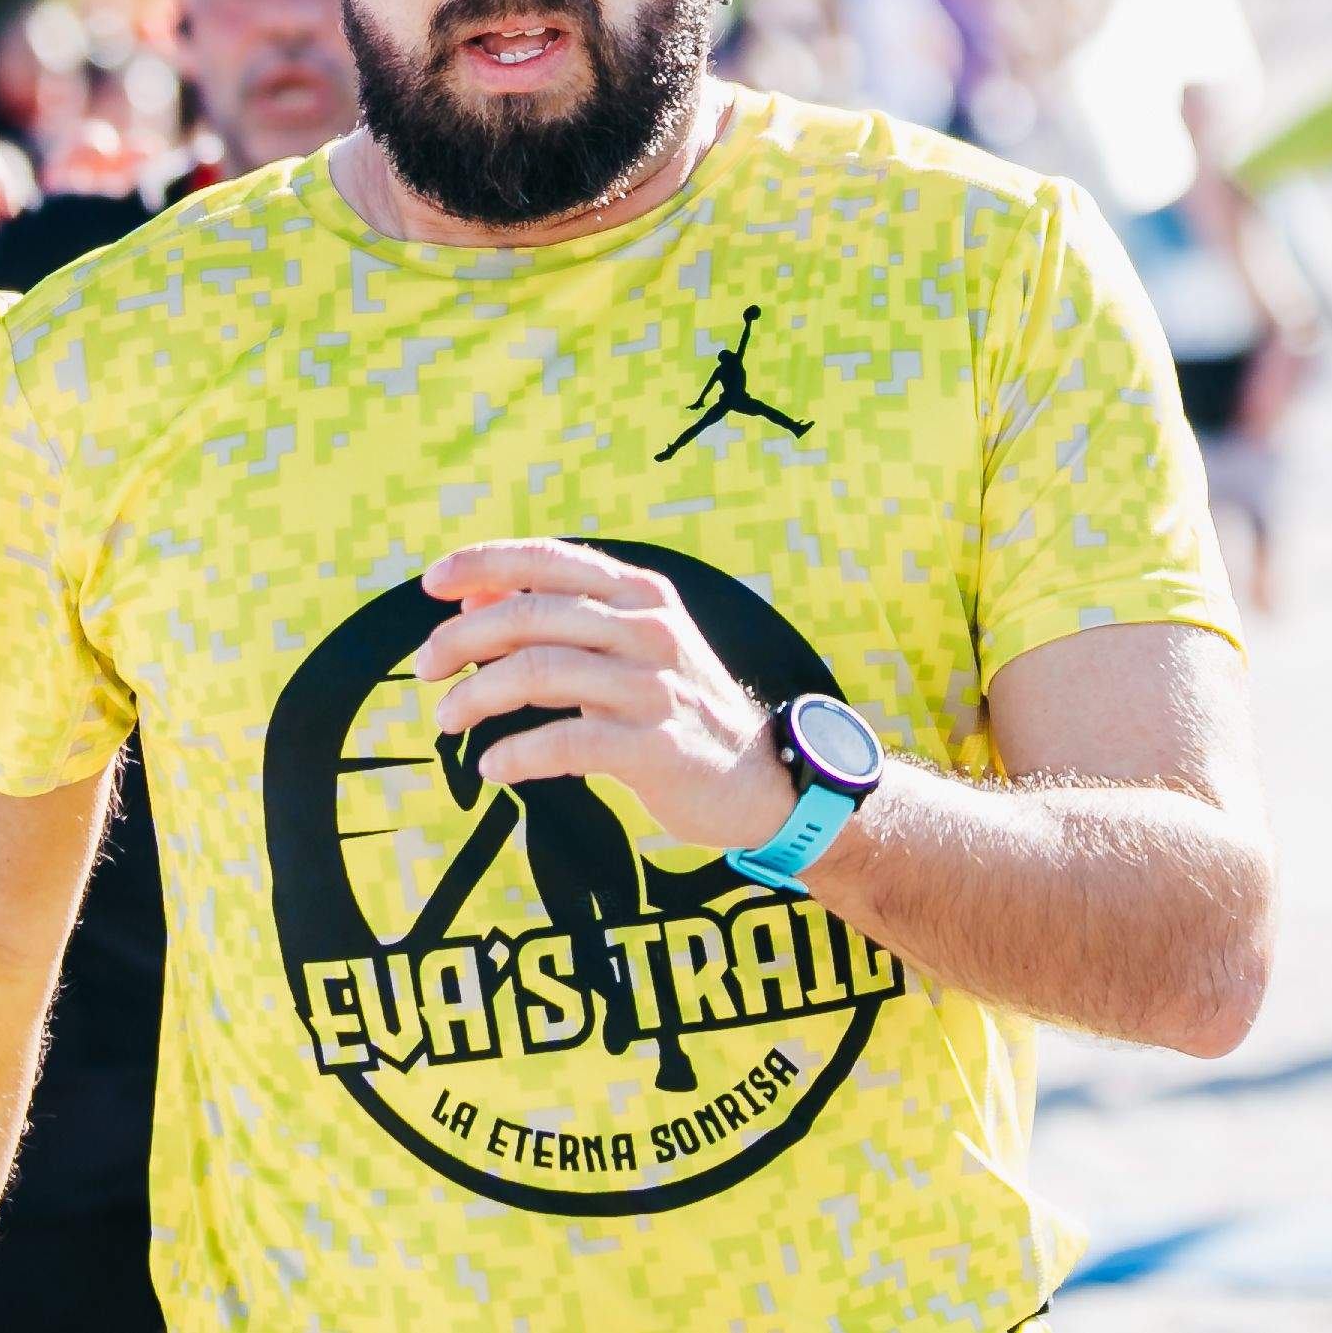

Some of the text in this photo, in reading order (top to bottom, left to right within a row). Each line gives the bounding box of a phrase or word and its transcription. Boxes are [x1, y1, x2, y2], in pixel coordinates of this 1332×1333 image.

[603, 898, 899, 1034] TRAIL
[430, 1046, 801, 1174] LA ETERNA SONRISA
